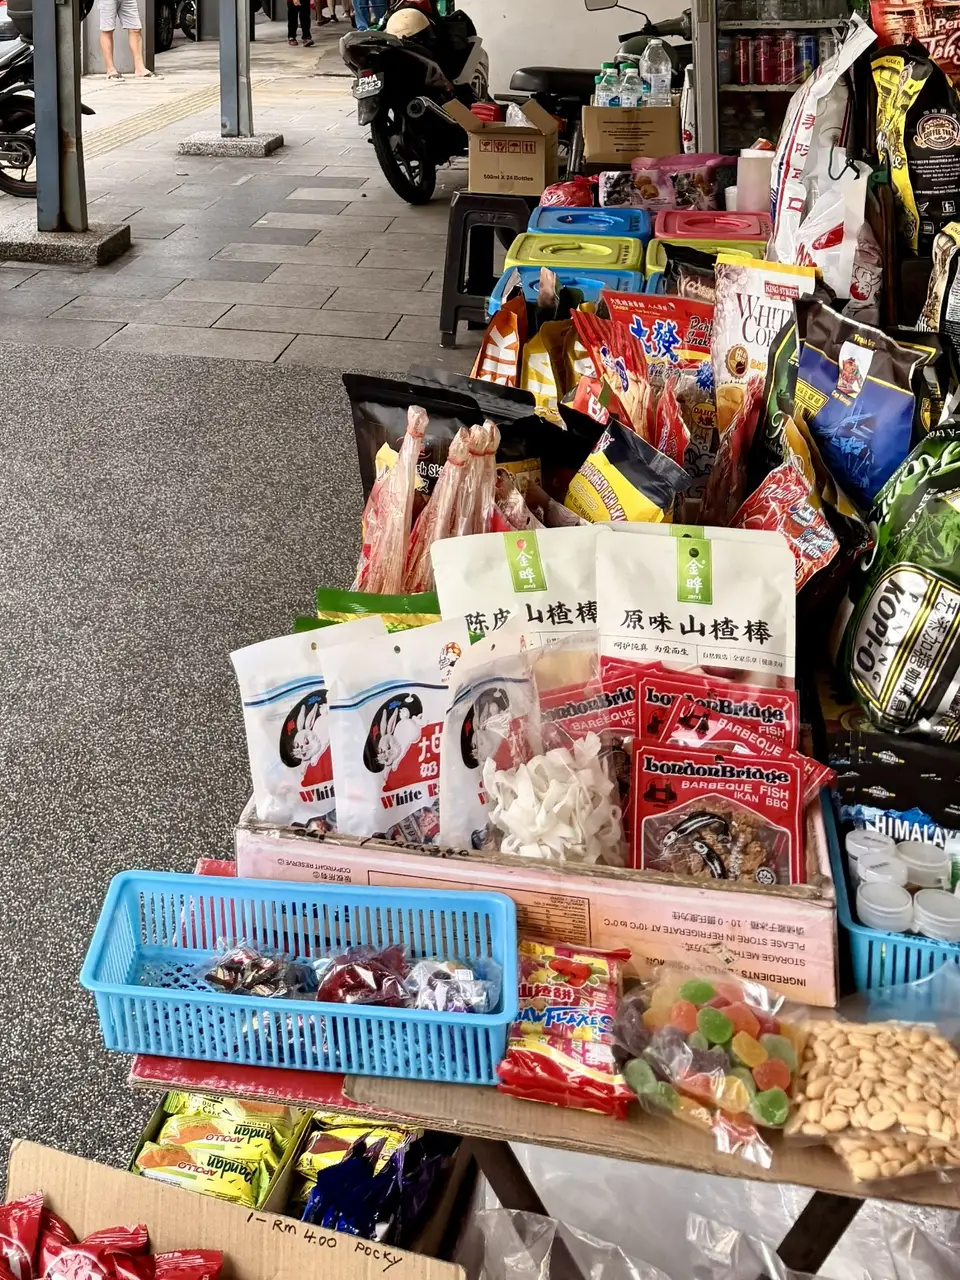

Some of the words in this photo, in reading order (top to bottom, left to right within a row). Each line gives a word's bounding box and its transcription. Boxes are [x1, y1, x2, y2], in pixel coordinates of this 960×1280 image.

[355, 80, 382, 94] 3323
[358, 74, 378, 86] PMA
[766, 283, 779, 293] KING
[736, 293, 792, 329] WHIT
[620, 609, 773, 645] 原味山楂棒
[856, 578, 906, 673] KOPI-O
[871, 592, 920, 684] PENANG
[653, 644, 690, 657] 为爱而生
[571, 709, 636, 731] BARBEQUE
[621, 718, 636, 727] IKA
[716, 717, 784, 757] BARBEQUE
[759, 725, 786, 737] FISH
[642, 755, 792, 785] LondonBridge
[299, 785, 335, 804] Whit
[681, 780, 753, 793] BARBEQUE
[759, 785, 790, 800] FISH
[381, 789, 422, 810] White
[734, 791, 760, 803] IKAN
[765, 797, 789, 810] BBQ
[319, 864, 351, 874] COPYRIGHT
[650, 924, 661, 933] AT
[662, 926, 725, 942] REFRIGERATE
[726, 934, 735, 943] IN
[737, 936, 768, 948] STORE
[770, 939, 805, 951] PLEASE
[733, 949, 760, 962] METH
[761, 953, 806, 967] STORAGE
[741, 969, 807, 987] INGREDIENTS
[205, 1132, 246, 1144] APOLLO
[233, 1123, 274, 1144] andan
[177, 1161, 218, 1177] APOLLO
[303, 1228, 337, 1248] 4.00
